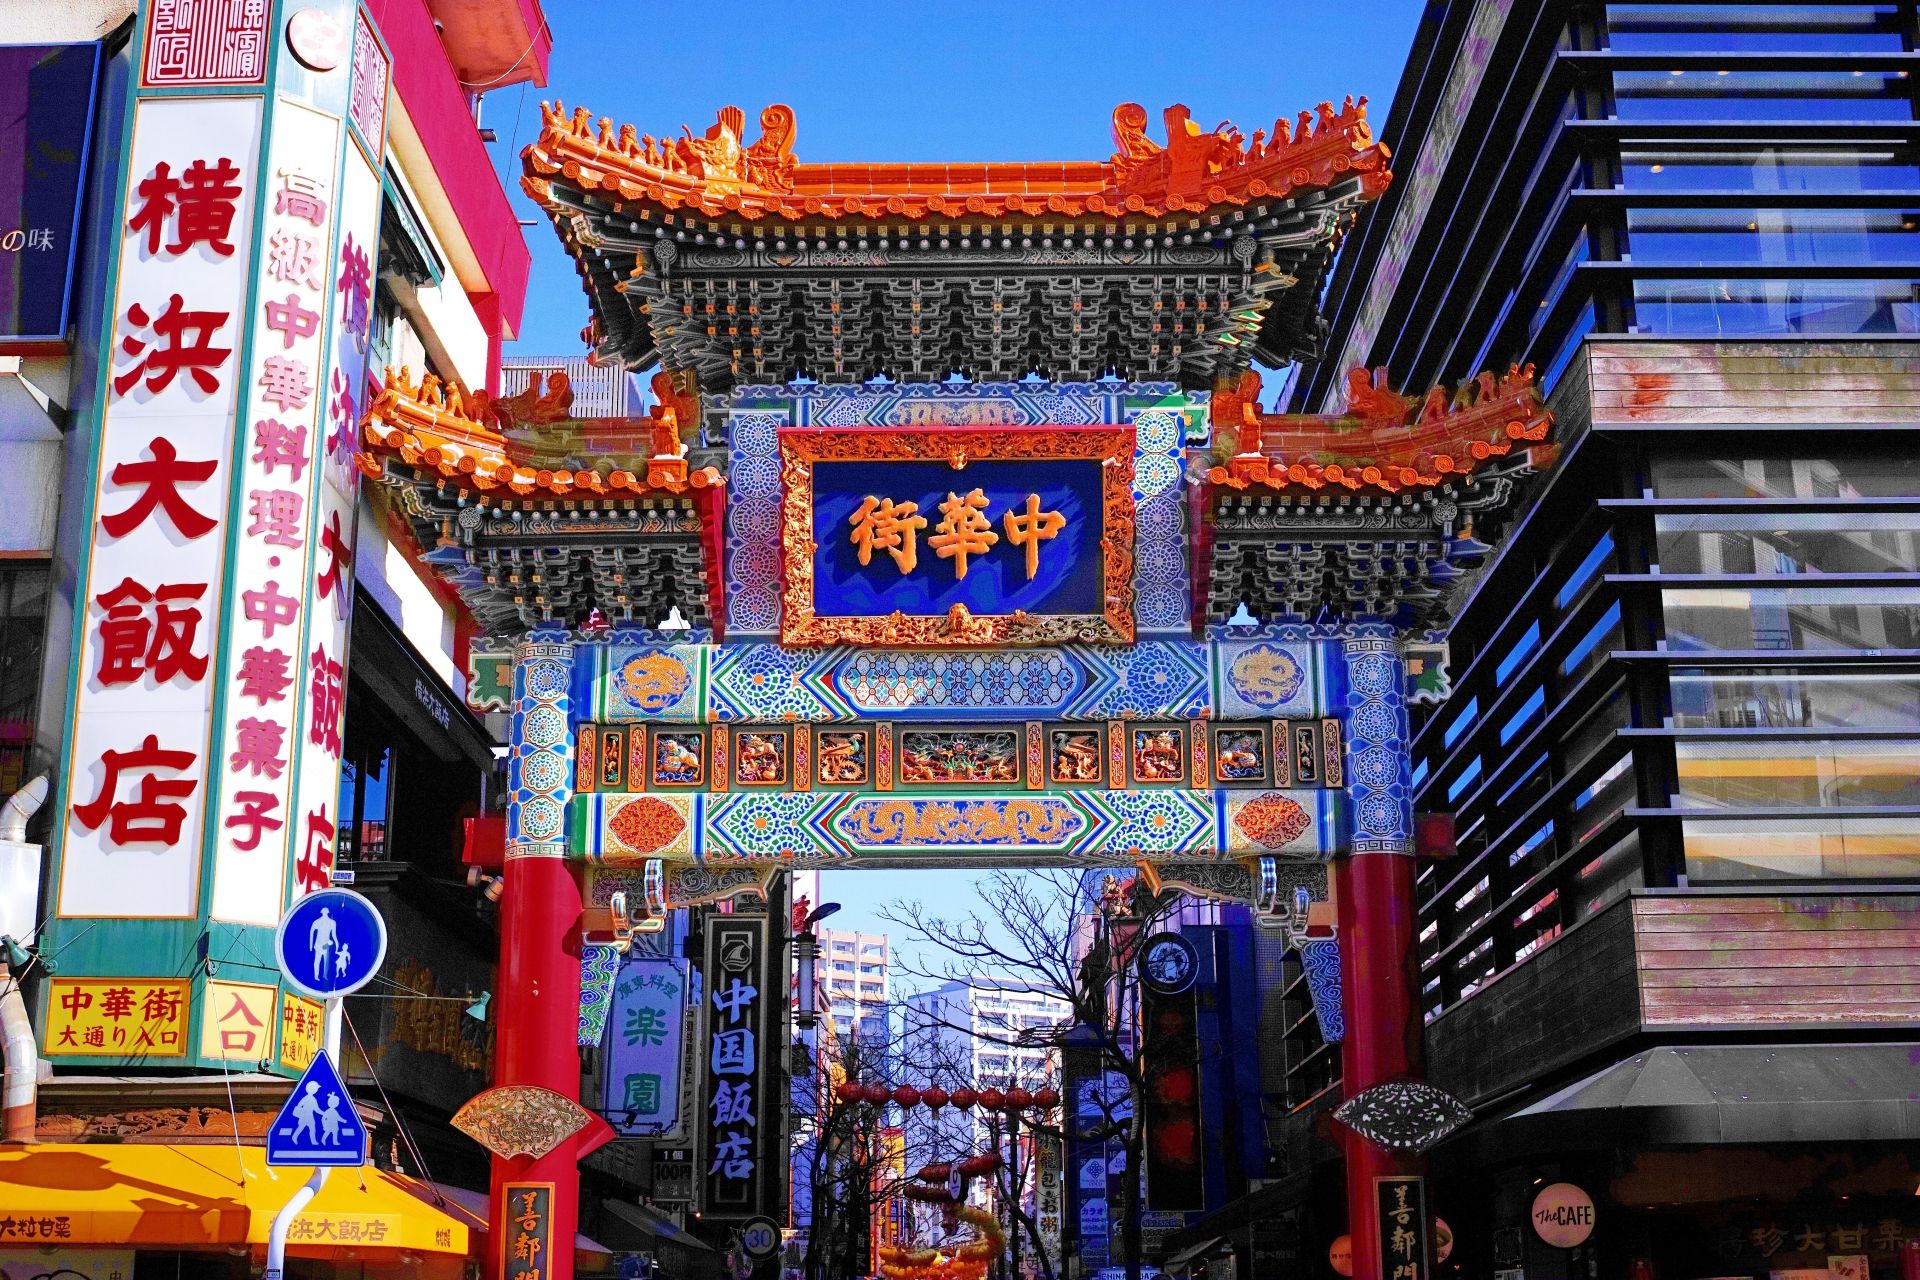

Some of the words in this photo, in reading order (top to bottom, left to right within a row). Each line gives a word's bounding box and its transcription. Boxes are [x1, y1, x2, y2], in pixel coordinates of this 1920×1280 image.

[72, 157, 242, 847] 横浜大飯店
[60, 986, 184, 1023] 中華街
[218, 991, 265, 1053] 入口
[283, 1000, 318, 1042] 中華街
[56, 1024, 179, 1048] 大通り入口
[708, 977, 758, 1180] 中国飯店
[1535, 1210, 1557, 1225] The
[1557, 1206, 1592, 1226] CAFE
[749, 1230, 771, 1248] 30
